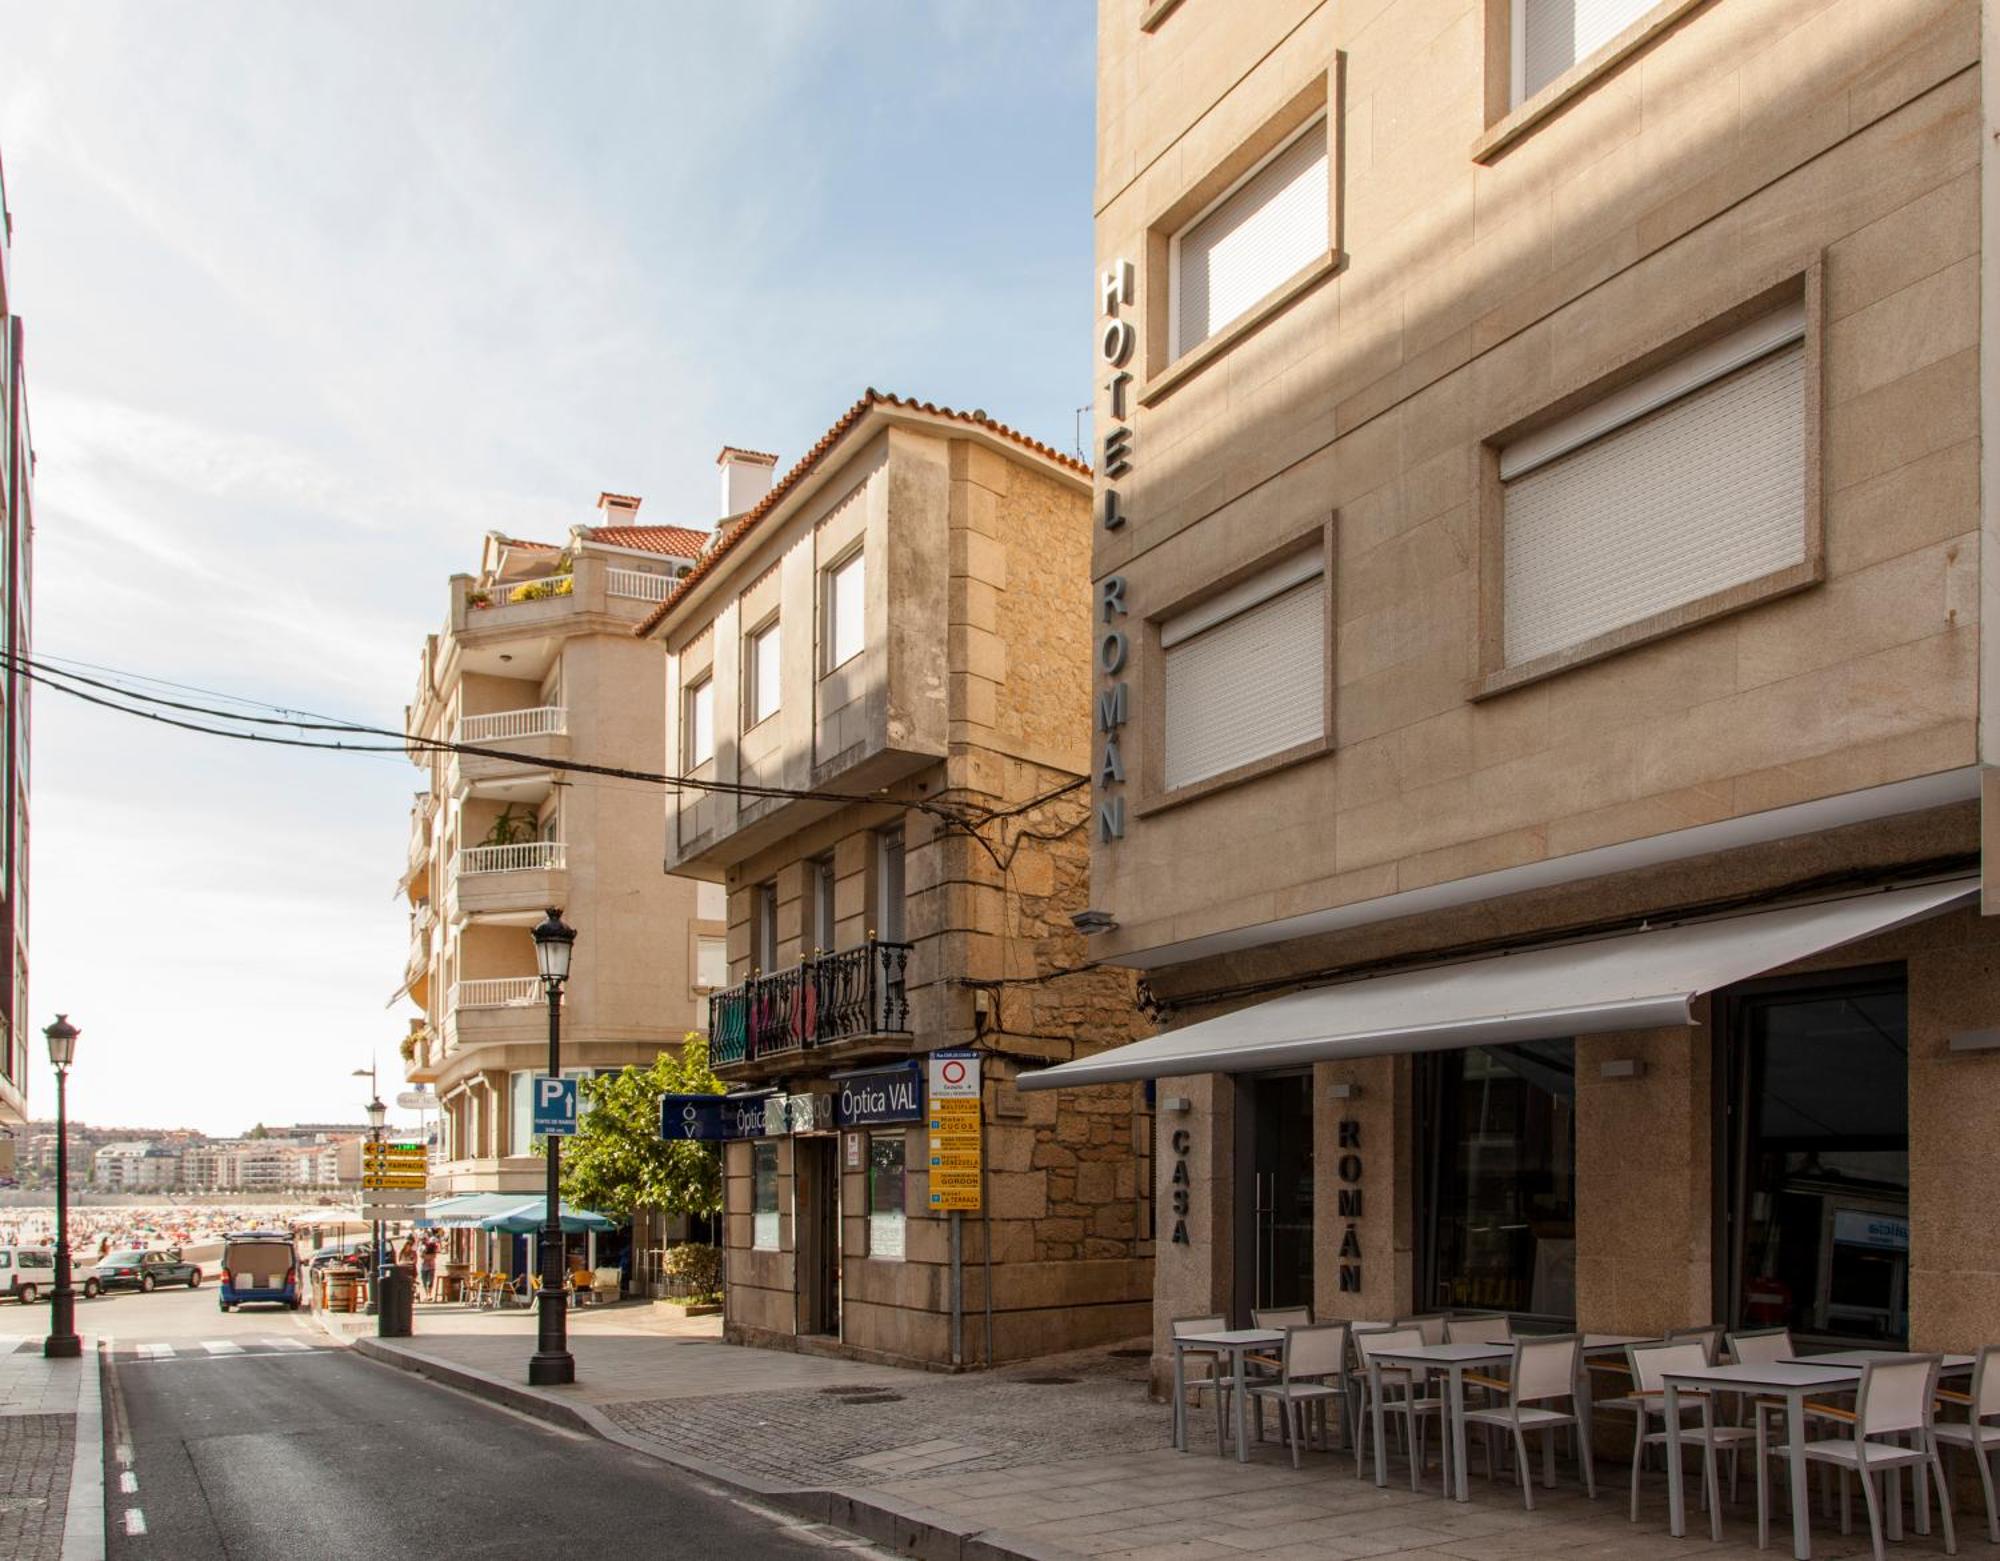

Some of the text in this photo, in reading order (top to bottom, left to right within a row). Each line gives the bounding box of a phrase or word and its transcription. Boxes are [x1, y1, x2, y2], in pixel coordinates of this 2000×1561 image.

[1101, 258, 1135, 529] HOTEL
[1099, 576, 1127, 843] ROMÁN
[541, 1080, 564, 1108] P
[842, 1081, 917, 1122] Óptica VAL
[1172, 1130, 1190, 1247] CASA
[1339, 1121, 1363, 1292] ROMÁN
